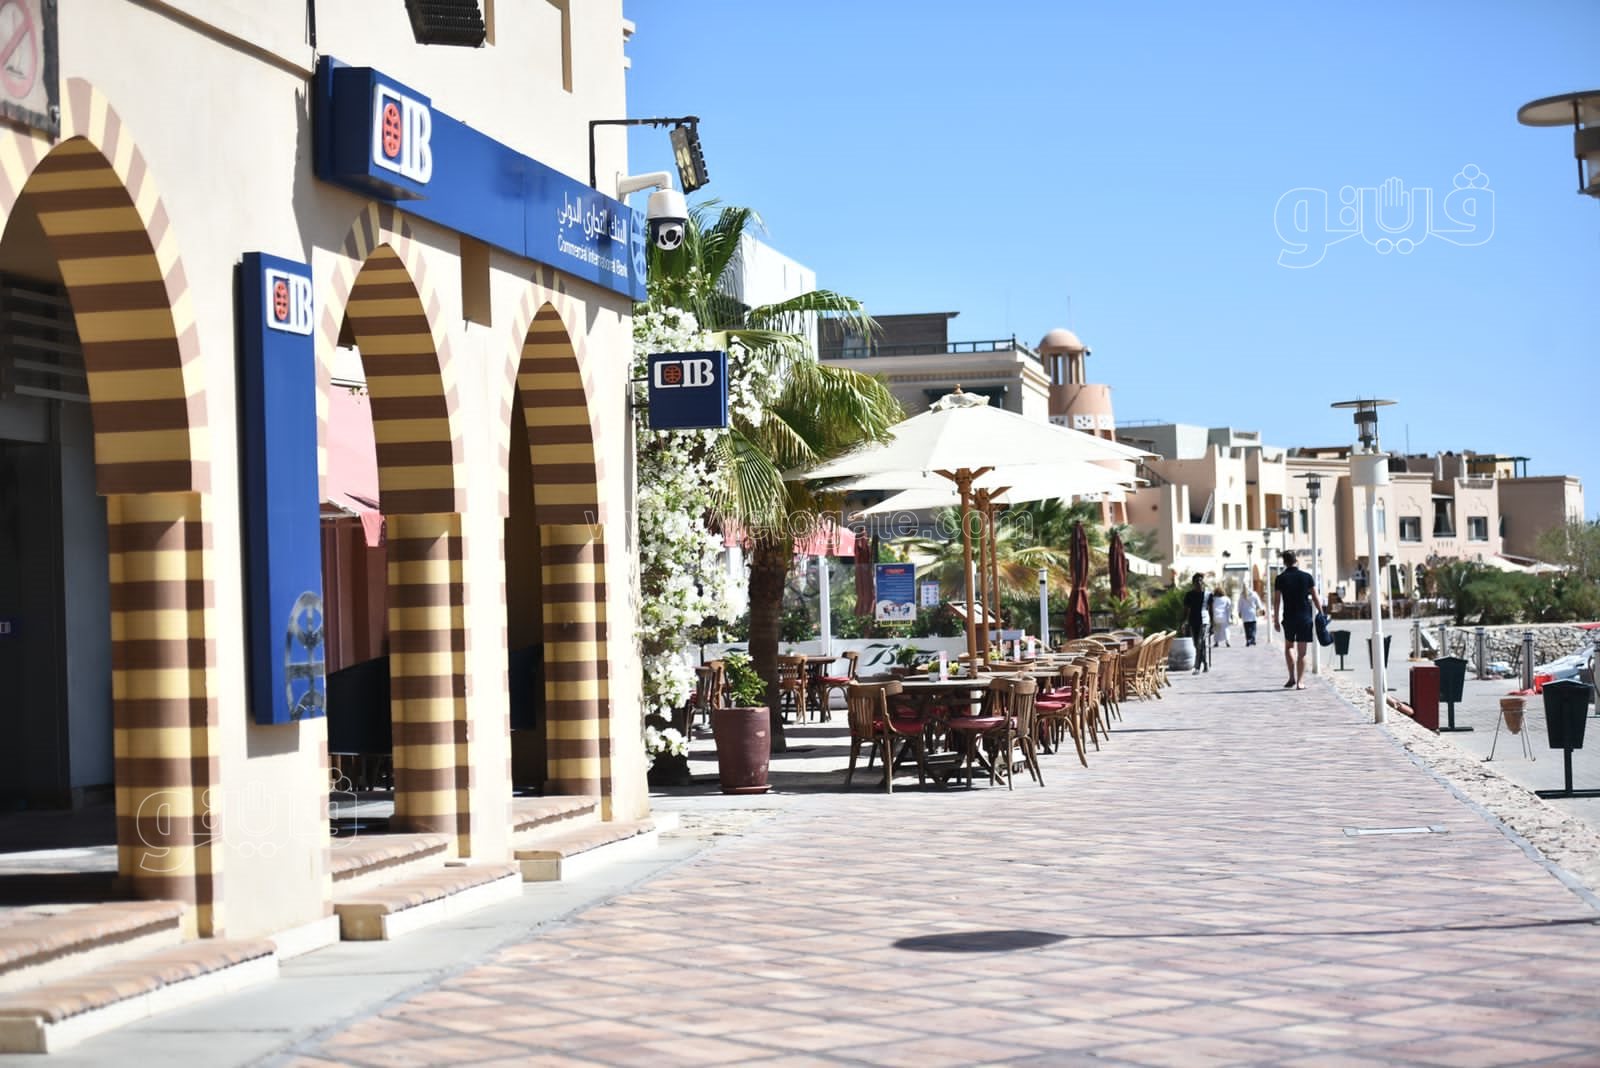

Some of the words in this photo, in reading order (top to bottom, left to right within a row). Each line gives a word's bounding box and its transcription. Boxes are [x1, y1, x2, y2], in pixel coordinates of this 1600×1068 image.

[373, 83, 432, 184] CIB
[556, 191, 582, 233] الدولي
[582, 202, 608, 242] التجاري
[609, 213, 627, 250] البنك
[557, 234, 587, 263] Commercial
[587, 247, 615, 274] International
[616, 259, 628, 278] Bank
[265, 268, 313, 336] CIB
[654, 358, 715, 389] CIB
[864, 643, 940, 667] Beze
